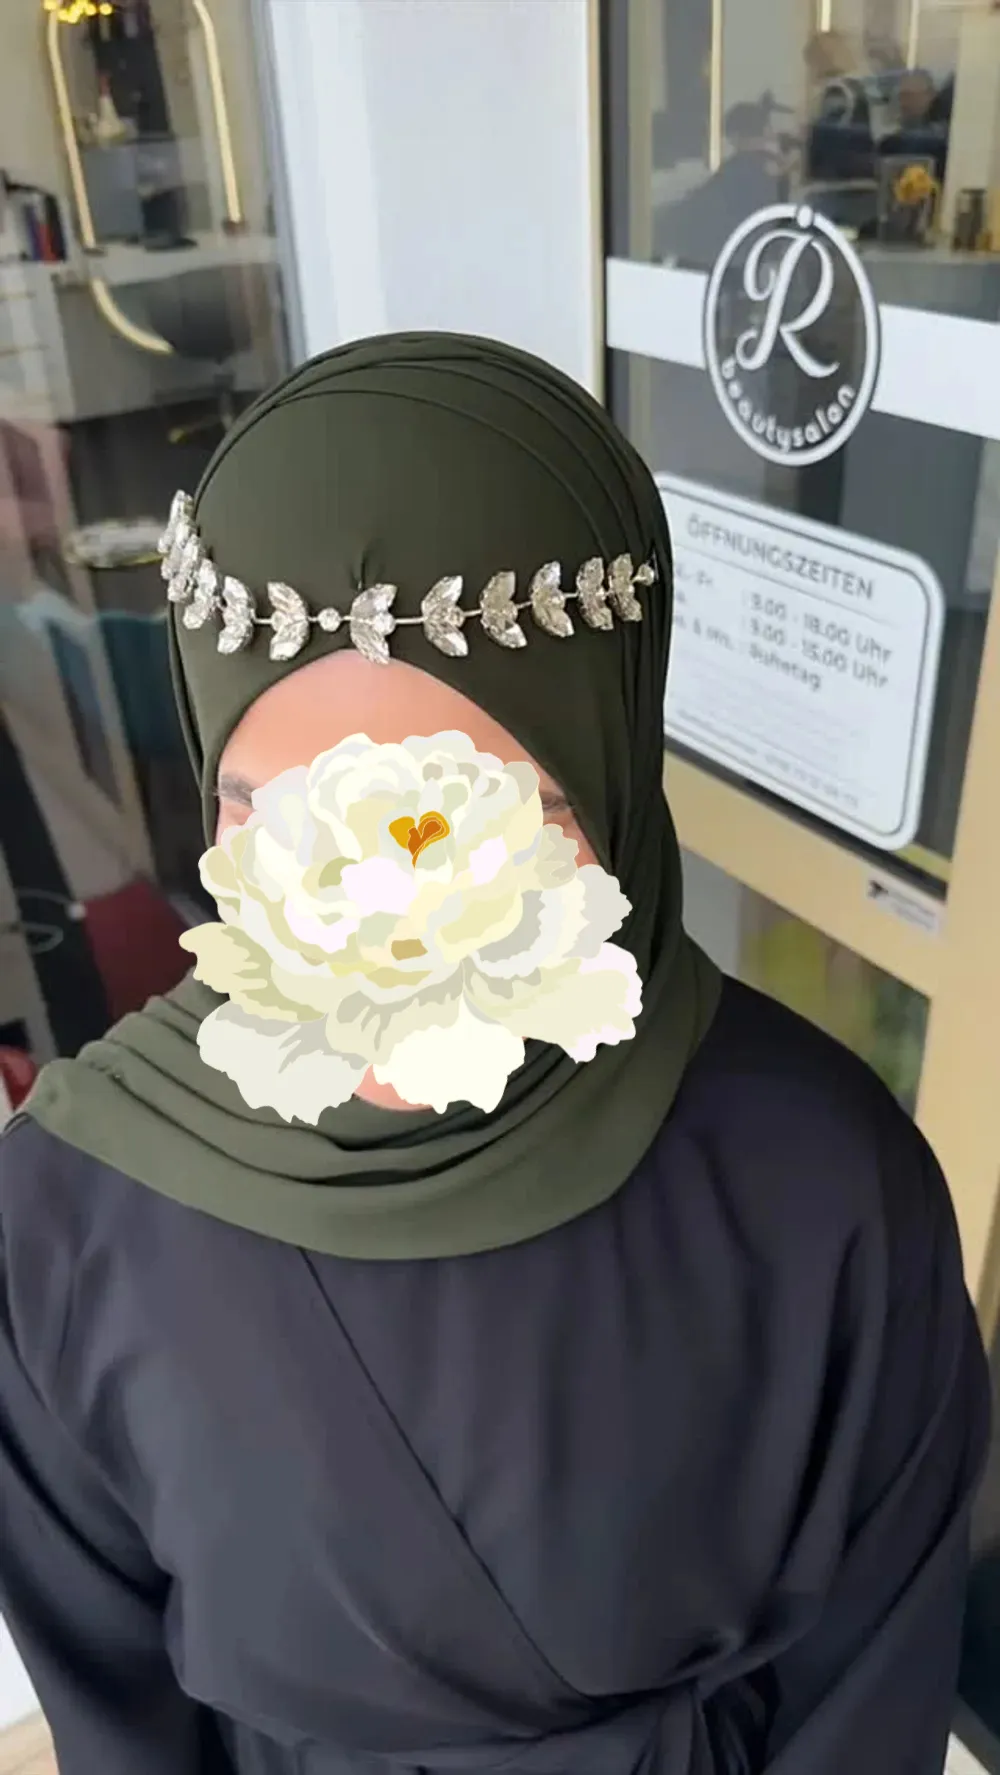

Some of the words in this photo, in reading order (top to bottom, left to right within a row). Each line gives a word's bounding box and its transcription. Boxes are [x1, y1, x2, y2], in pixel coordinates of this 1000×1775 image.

[735, 228, 840, 378] R
[721, 355, 857, 454] beautysalon
[686, 513, 875, 601] ÖFFNUNGSZEITEN
[852, 660, 889, 689] Uhr
[855, 631, 893, 664] Uhr
